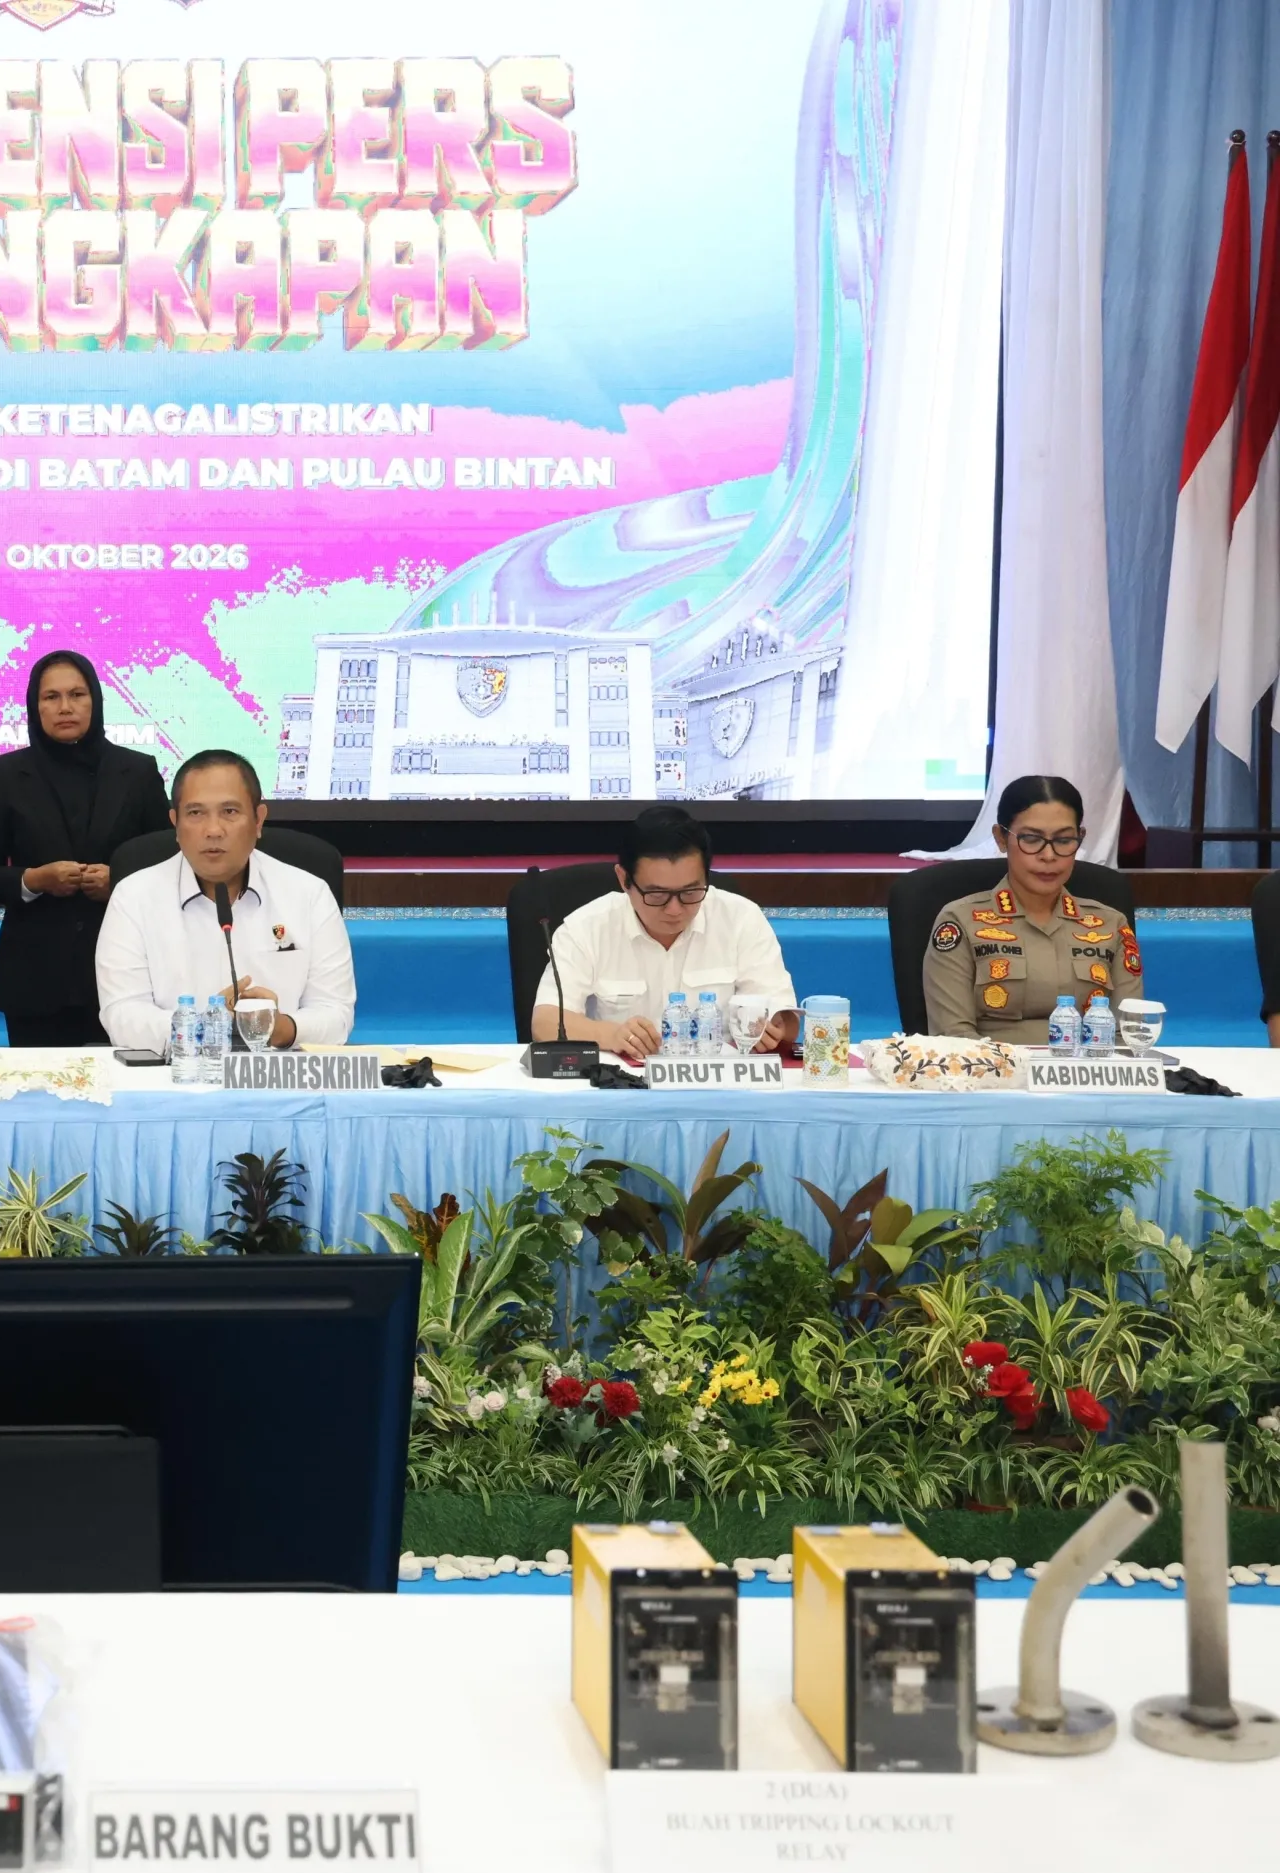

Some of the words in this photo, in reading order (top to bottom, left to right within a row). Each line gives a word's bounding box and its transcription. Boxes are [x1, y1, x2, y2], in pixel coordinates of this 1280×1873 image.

[234, 55, 579, 215] PERS
[38, 457, 191, 490] BATAM
[198, 457, 294, 490] DAN
[301, 456, 447, 490] PULAU
[453, 456, 617, 489] BINTAN
[6, 543, 165, 571] OKTOBER
[170, 543, 250, 571] 2026
[224, 1055, 379, 1090] KABARESKRIM
[651, 1063, 725, 1083] DIRUT
[733, 1063, 781, 1083] PLN
[1031, 1065, 1159, 1087] KABIDHUMAS
[766, 1781, 777, 1800] 2
[781, 1780, 850, 1803] (DUA)
[666, 1813, 732, 1832] BUAH
[738, 1813, 839, 1832] TRIPPING
[845, 1813, 955, 1833] LOCKOUT
[94, 1813, 270, 1860] BARANG
[286, 1813, 417, 1860] BUKTI
[776, 1842, 850, 1862] RELAY
